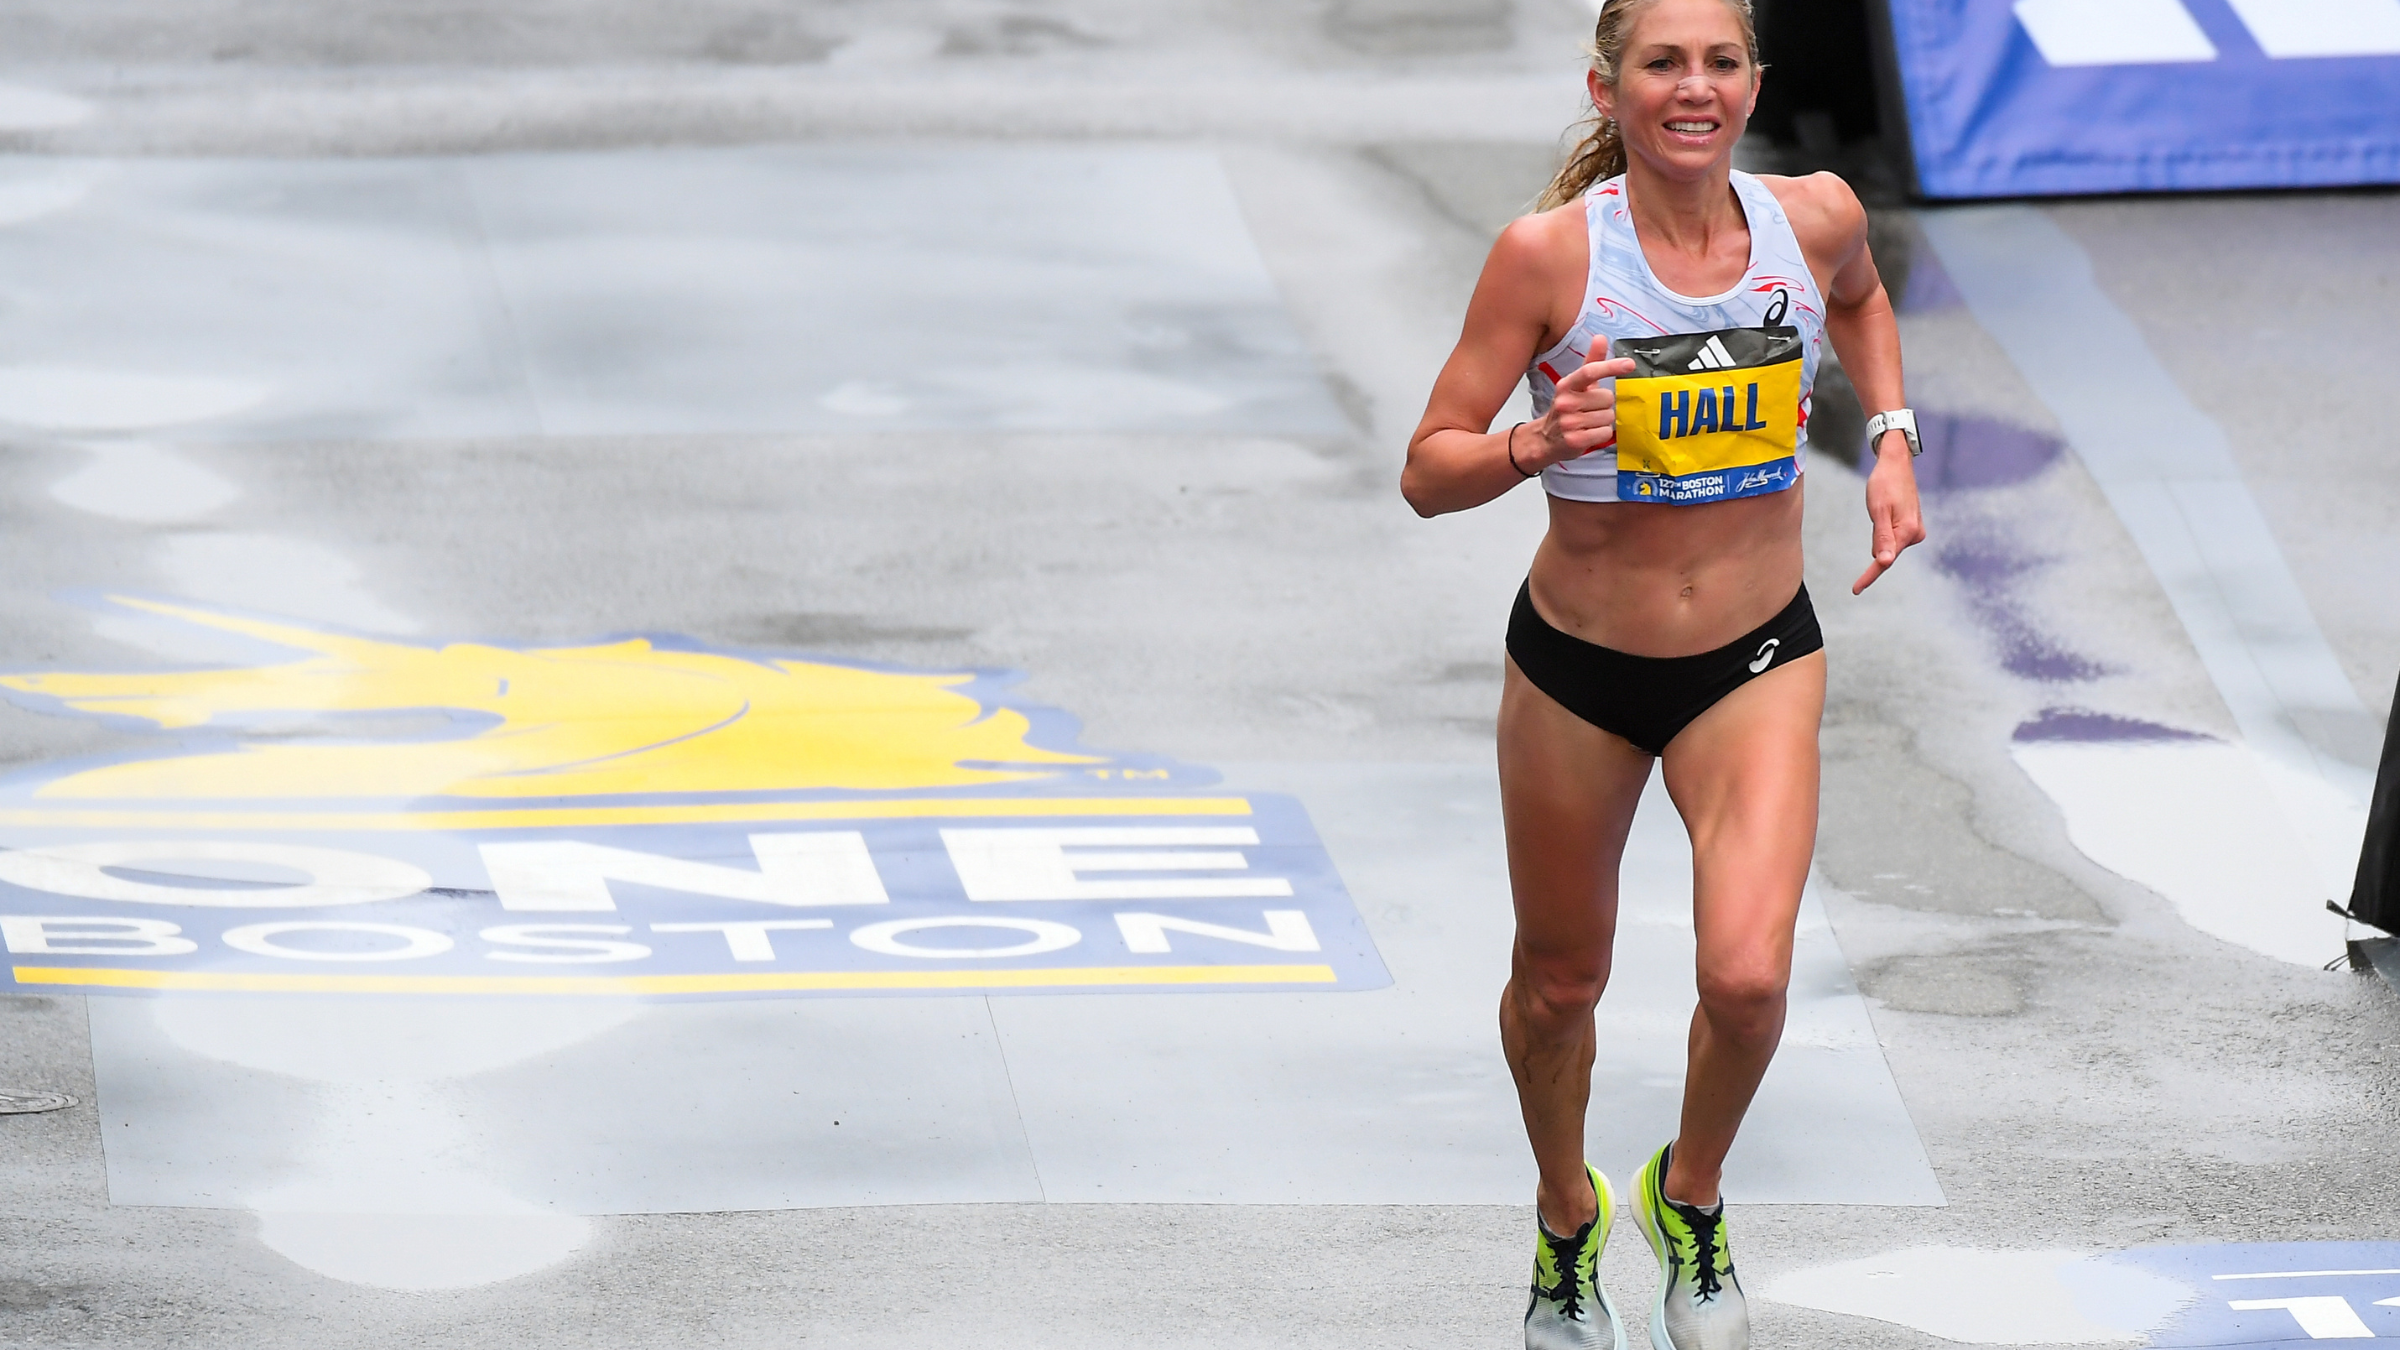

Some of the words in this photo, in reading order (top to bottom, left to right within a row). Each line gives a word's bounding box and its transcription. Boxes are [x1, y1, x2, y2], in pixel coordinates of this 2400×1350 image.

[1659, 382, 1767, 441] HALL
[1659, 485, 1725, 500] MARATHON
[1682, 475, 1723, 490] BOSTON
[0, 826, 1295, 911] ONE
[0, 909, 1322, 964] BOSTON
